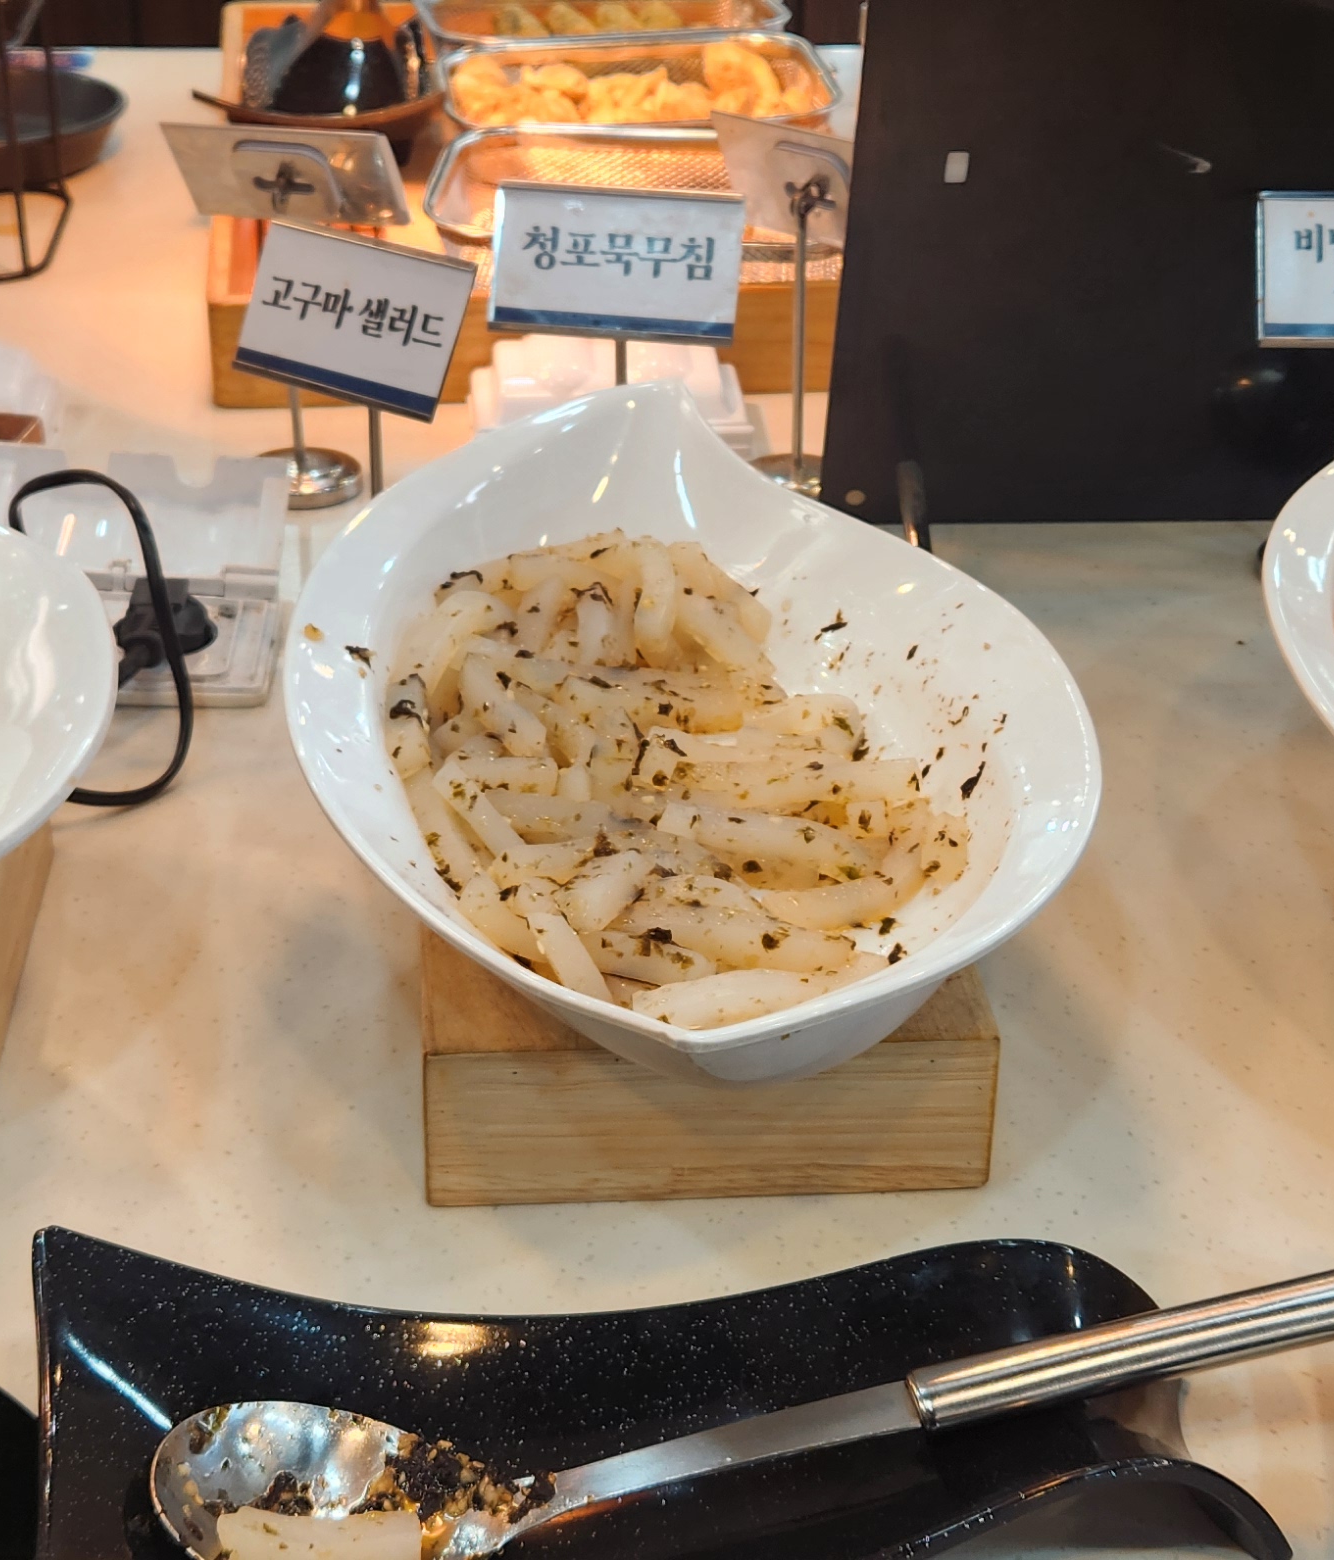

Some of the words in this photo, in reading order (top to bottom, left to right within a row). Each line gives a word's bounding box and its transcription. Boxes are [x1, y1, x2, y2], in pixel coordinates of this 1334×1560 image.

[522, 225, 715, 281] 청포묵무침
[262, 276, 354, 330] 고구마
[358, 297, 445, 348] 샐러드
